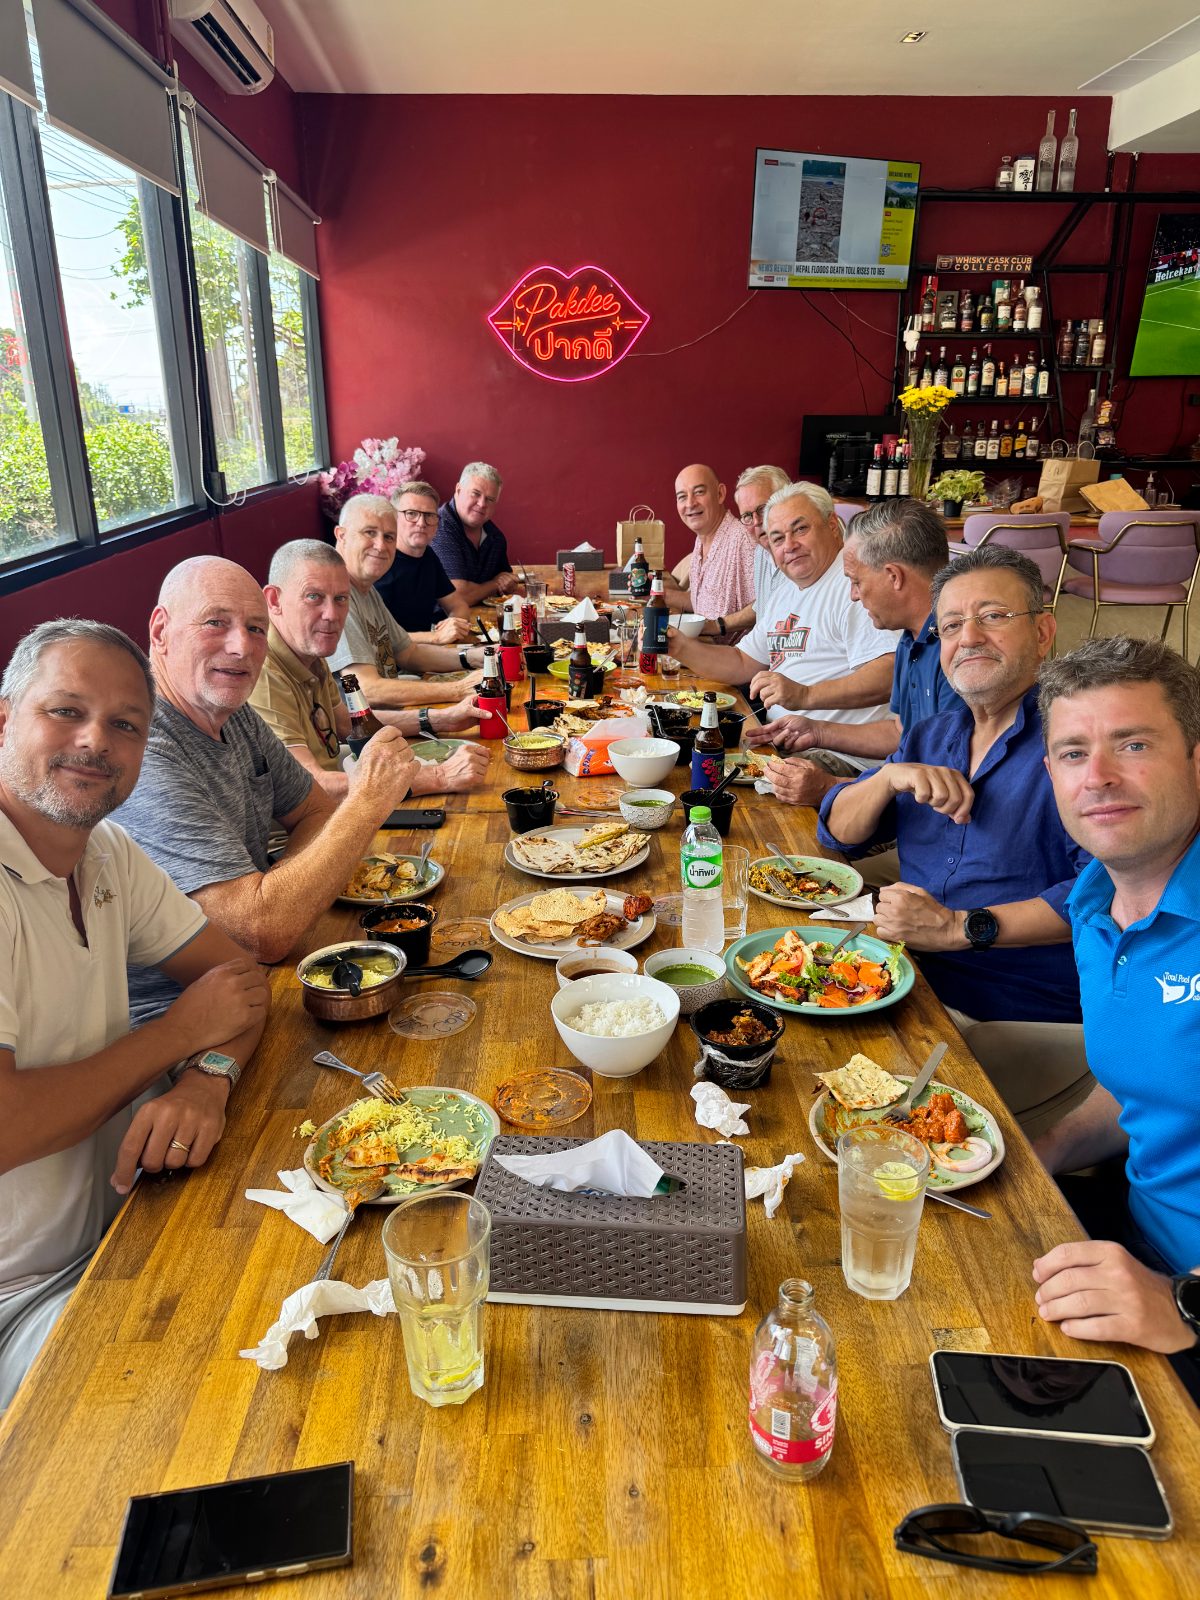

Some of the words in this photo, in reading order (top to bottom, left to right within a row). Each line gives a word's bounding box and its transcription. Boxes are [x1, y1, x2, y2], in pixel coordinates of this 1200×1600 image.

[955, 256, 987, 264] WHISKY
[1011, 257, 1032, 265] CLUB
[757, 263, 773, 272] NEWS
[796, 265, 810, 274] NEPAL
[811, 266, 829, 274] FLOODS
[830, 266, 845, 275] DEATH
[845, 267, 856, 275] TOLL
[857, 267, 870, 276] RISES
[870, 268, 877, 276] TO
[515, 283, 621, 337] Pakdee
[534, 328, 613, 361] ปากดี
